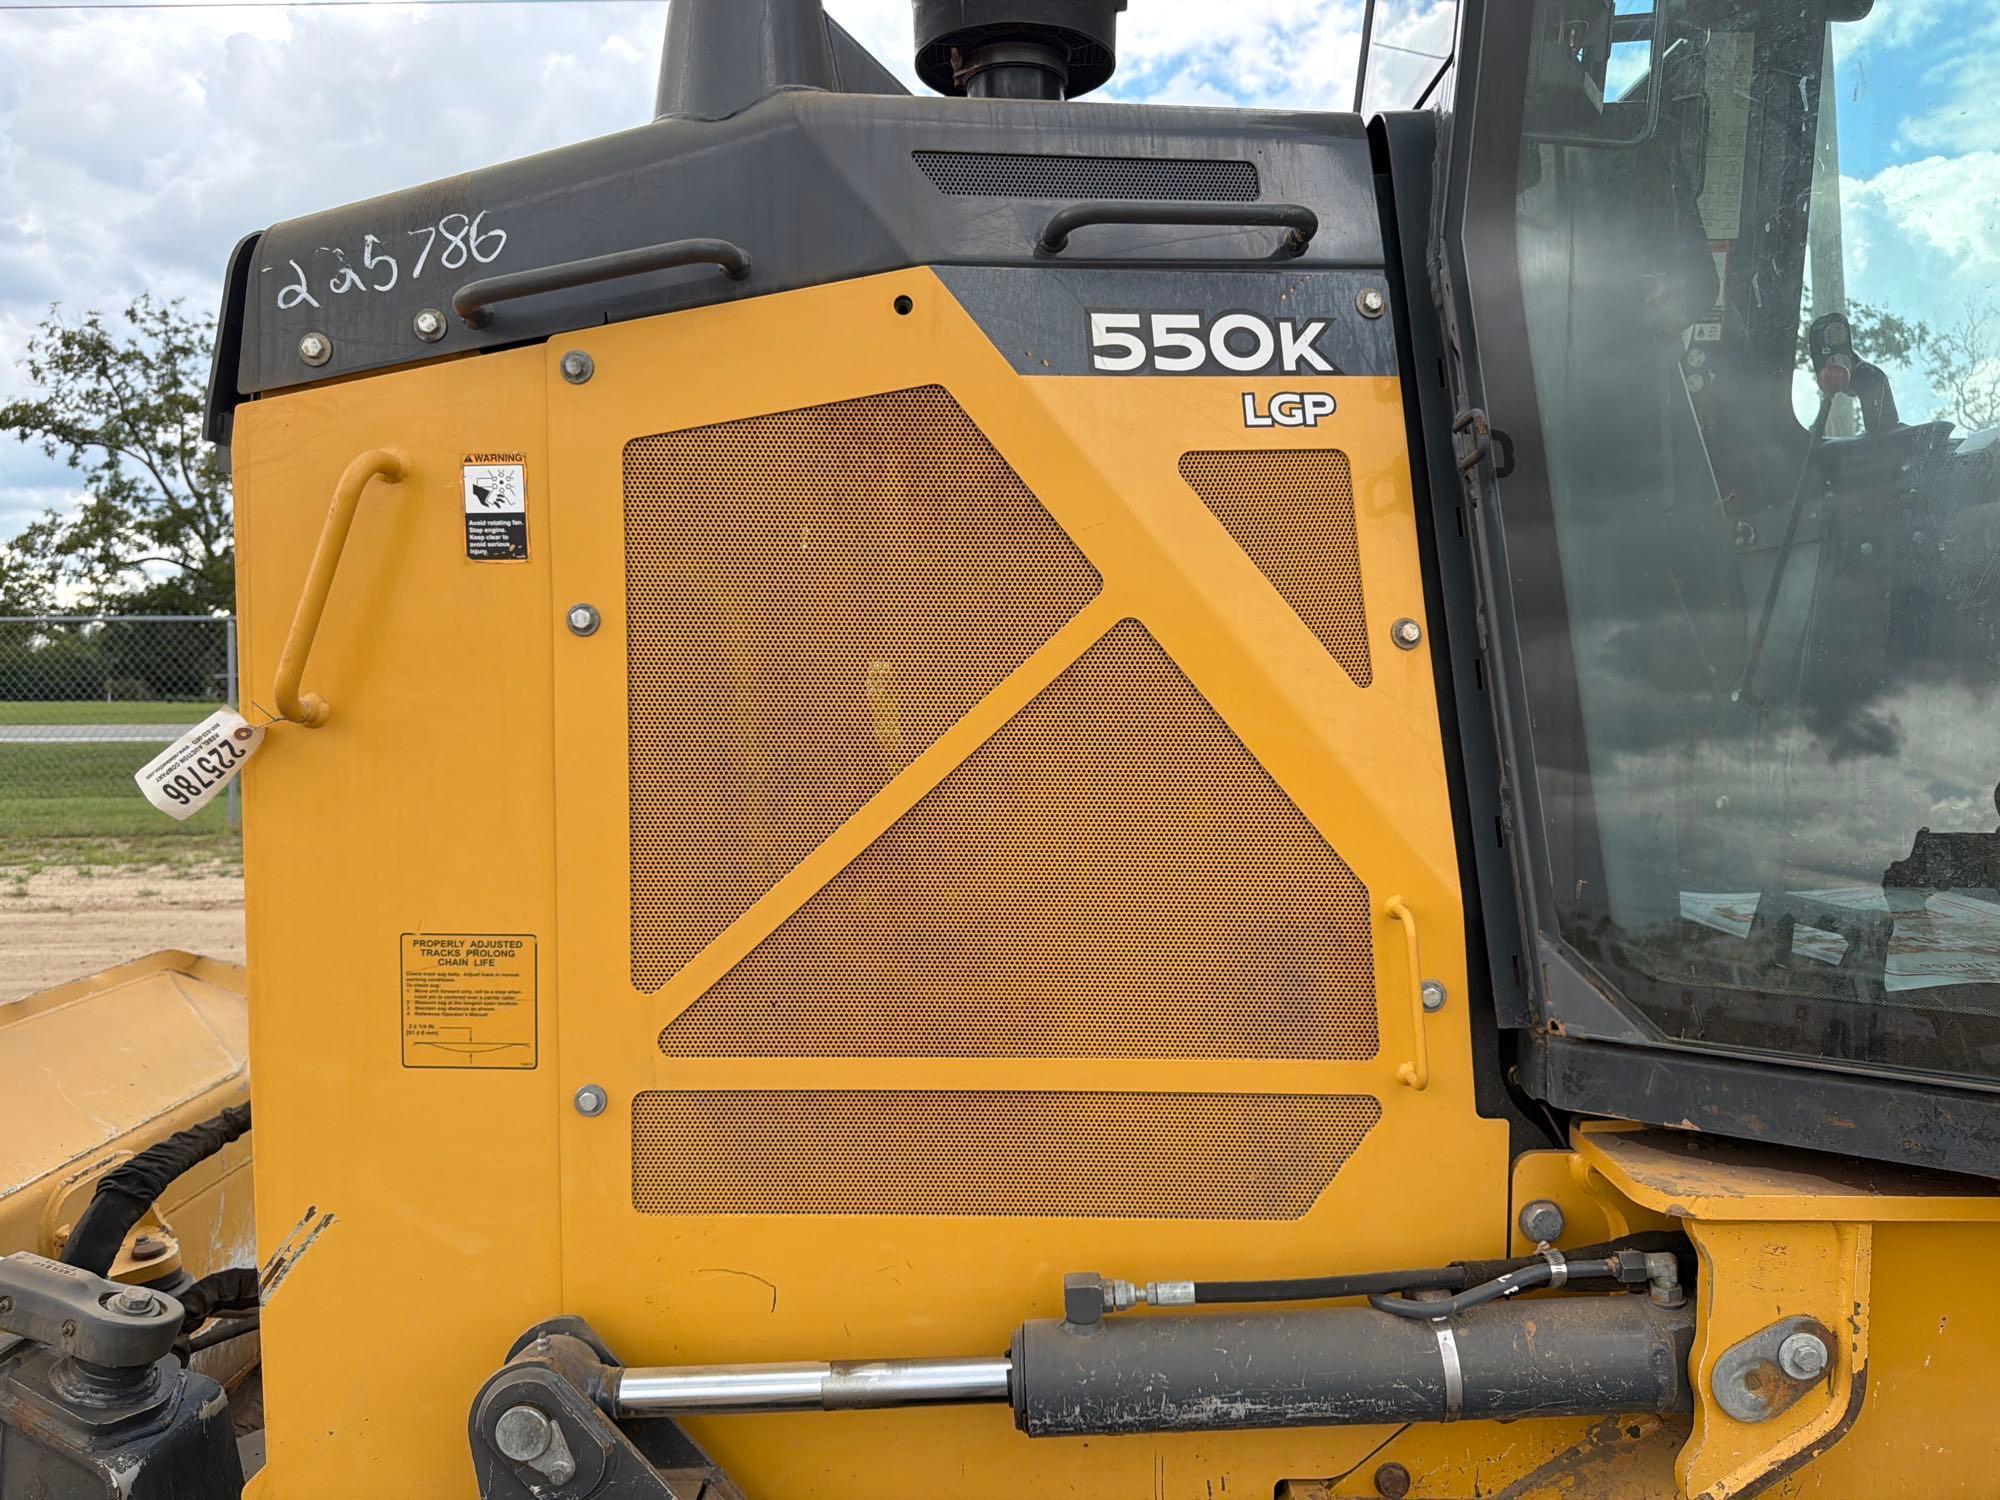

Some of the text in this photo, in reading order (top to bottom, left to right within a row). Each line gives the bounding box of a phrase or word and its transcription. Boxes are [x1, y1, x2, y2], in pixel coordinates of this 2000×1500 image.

[1090, 312, 1336, 372] 550K
[1242, 392, 1336, 428] LGP
[474, 454, 523, 462] WARNING
[487, 519, 511, 527] rotating
[469, 526, 483, 534] Stop
[156, 733, 220, 783] REBEL AUCTION COMPANY
[162, 739, 247, 805] 225786
[413, 940, 523, 949] PROPERLY ADJUSTED
[420, 949, 516, 958] TRACKS PROLONG
[438, 958, 495, 967] CHAIN LIFE
